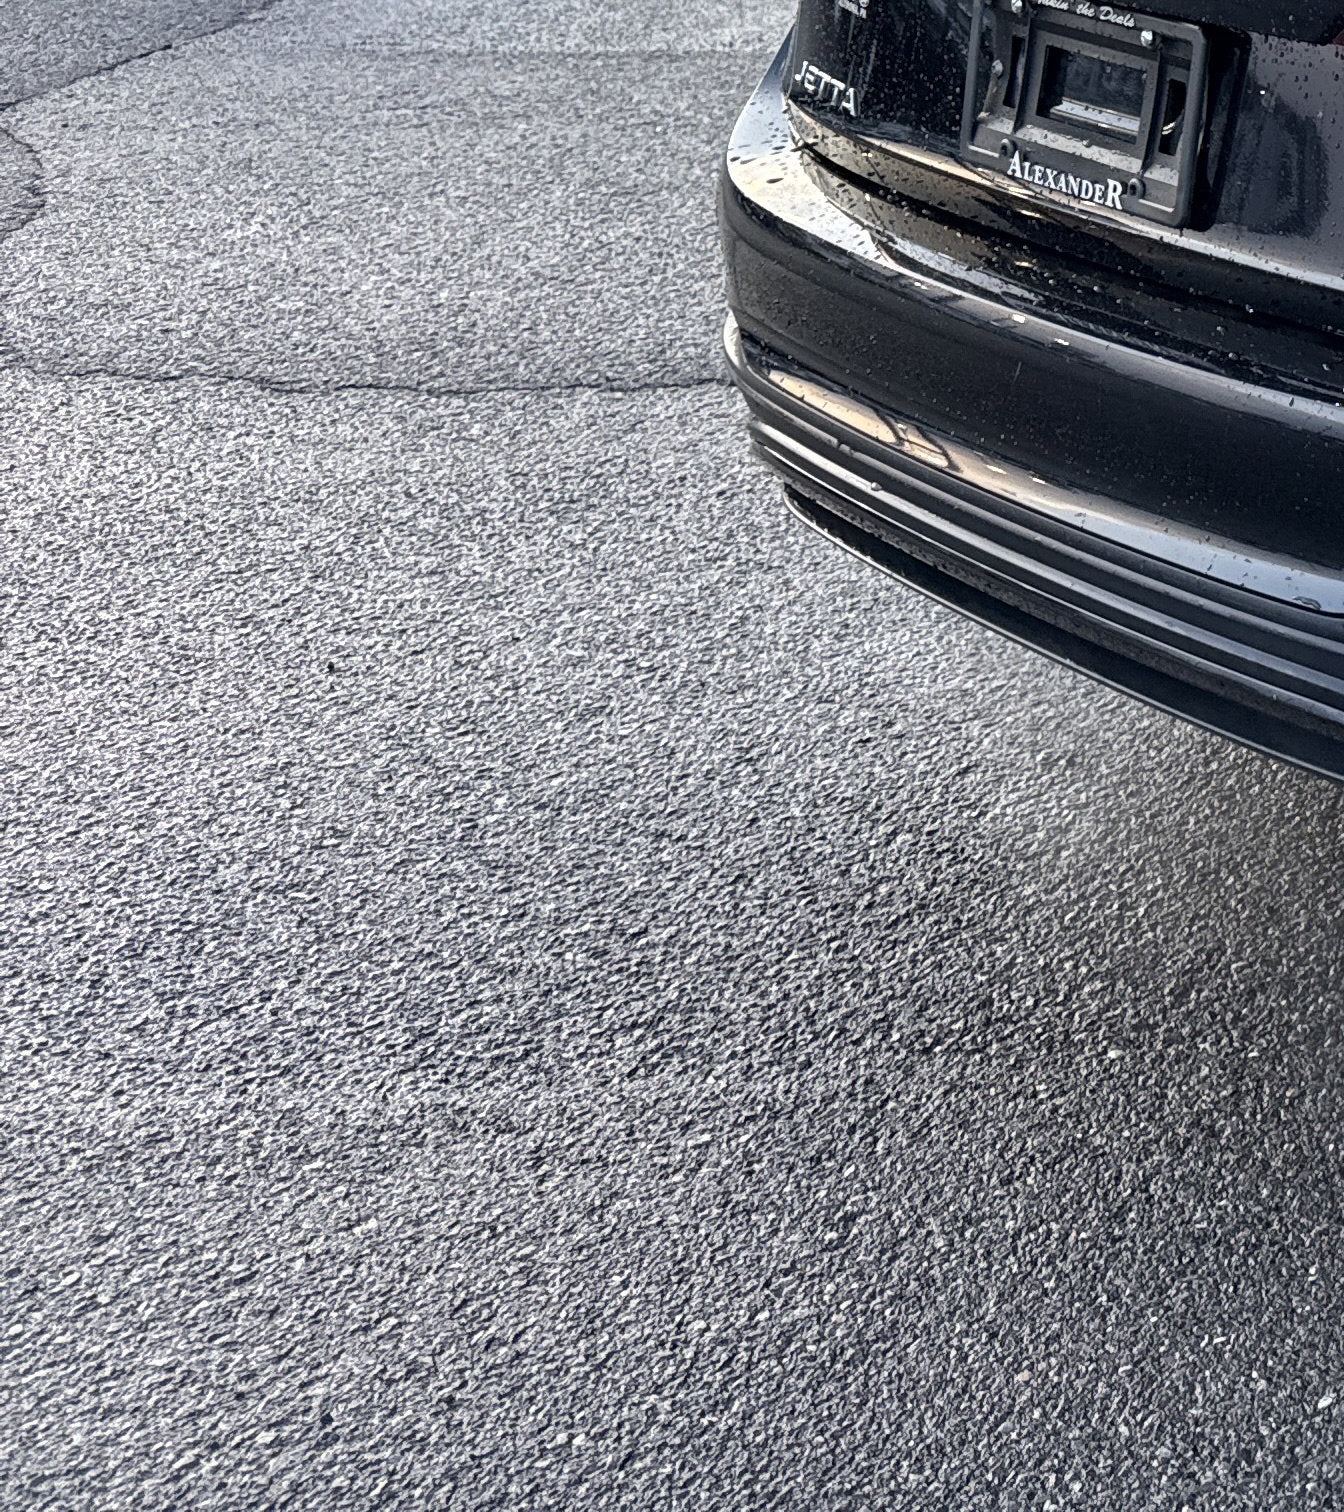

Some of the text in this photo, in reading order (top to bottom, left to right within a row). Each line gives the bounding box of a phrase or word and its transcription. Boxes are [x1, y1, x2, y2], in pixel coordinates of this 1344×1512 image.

[1076, 2, 1096, 18] the
[1099, 6, 1136, 28] Deals
[795, 61, 861, 117] JETTA
